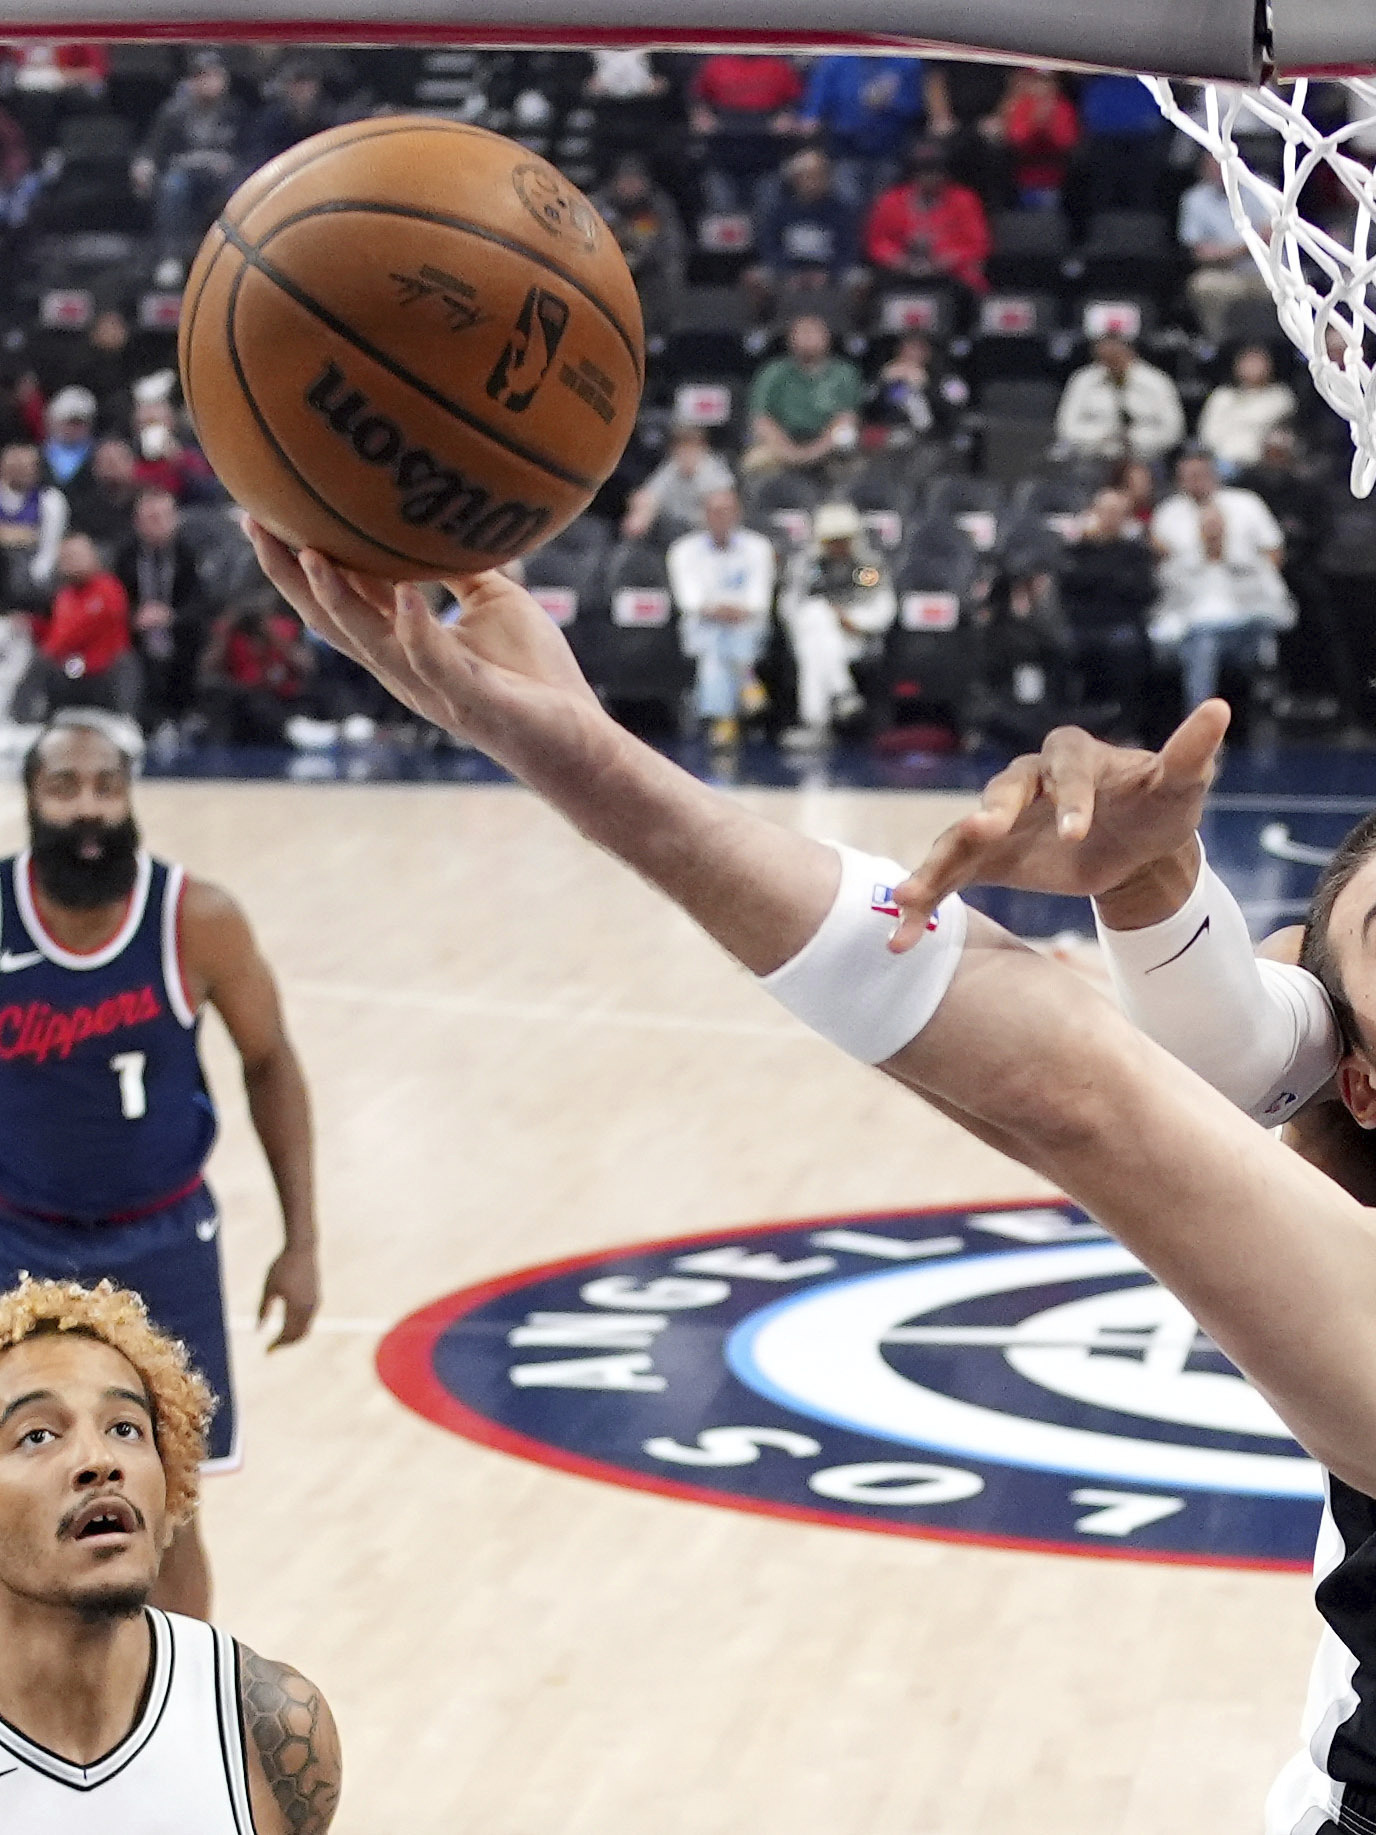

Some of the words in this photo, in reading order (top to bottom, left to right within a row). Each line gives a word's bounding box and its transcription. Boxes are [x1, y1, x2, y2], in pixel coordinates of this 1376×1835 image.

[305, 359, 554, 555] Wilson
[0, 986, 161, 1064] Clippers
[110, 1051, 147, 1120] 1
[508, 1208, 1114, 1393] ANGELE
[643, 1425, 1187, 1538] LOS
